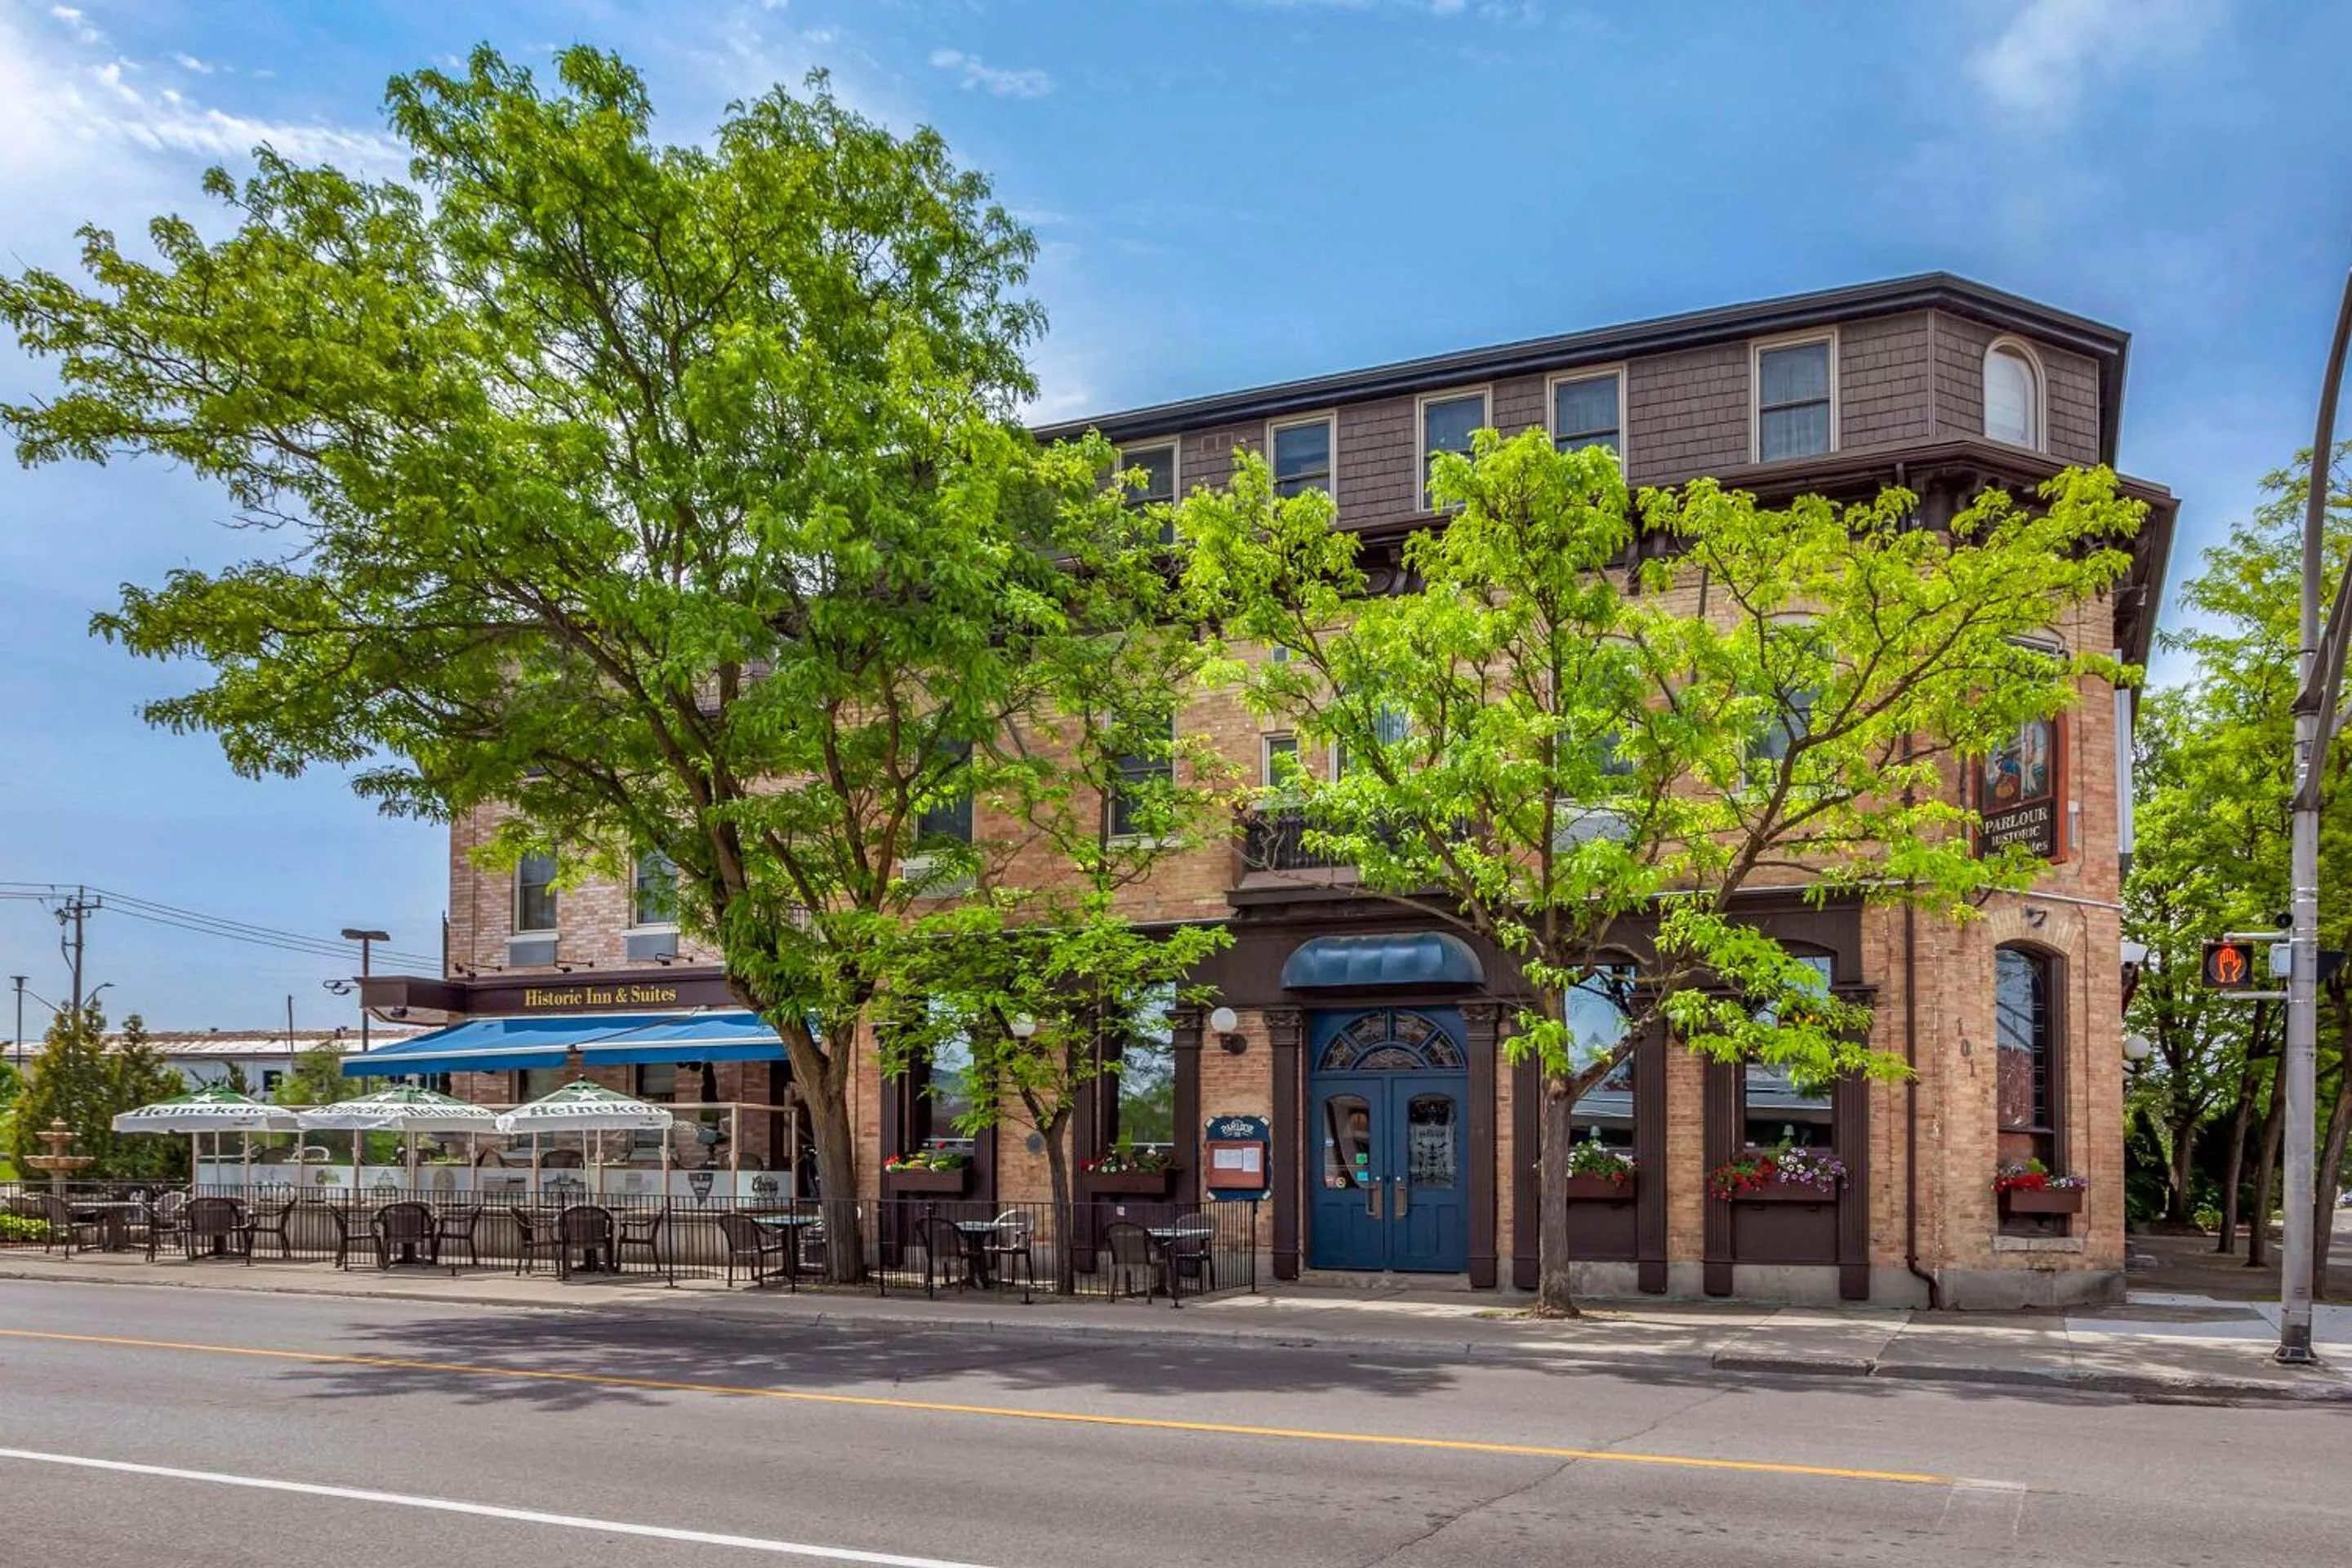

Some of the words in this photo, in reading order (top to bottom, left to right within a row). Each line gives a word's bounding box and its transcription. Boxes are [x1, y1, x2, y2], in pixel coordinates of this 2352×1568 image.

[1984, 807, 2047, 835] PARLOUR
[524, 989, 582, 1006] Historic
[586, 987, 612, 1004] Inn
[616, 987, 627, 1003] &
[630, 985, 676, 1003] Suites
[1956, 1017, 1976, 1078] 101
[530, 1103, 667, 1116] Heineken
